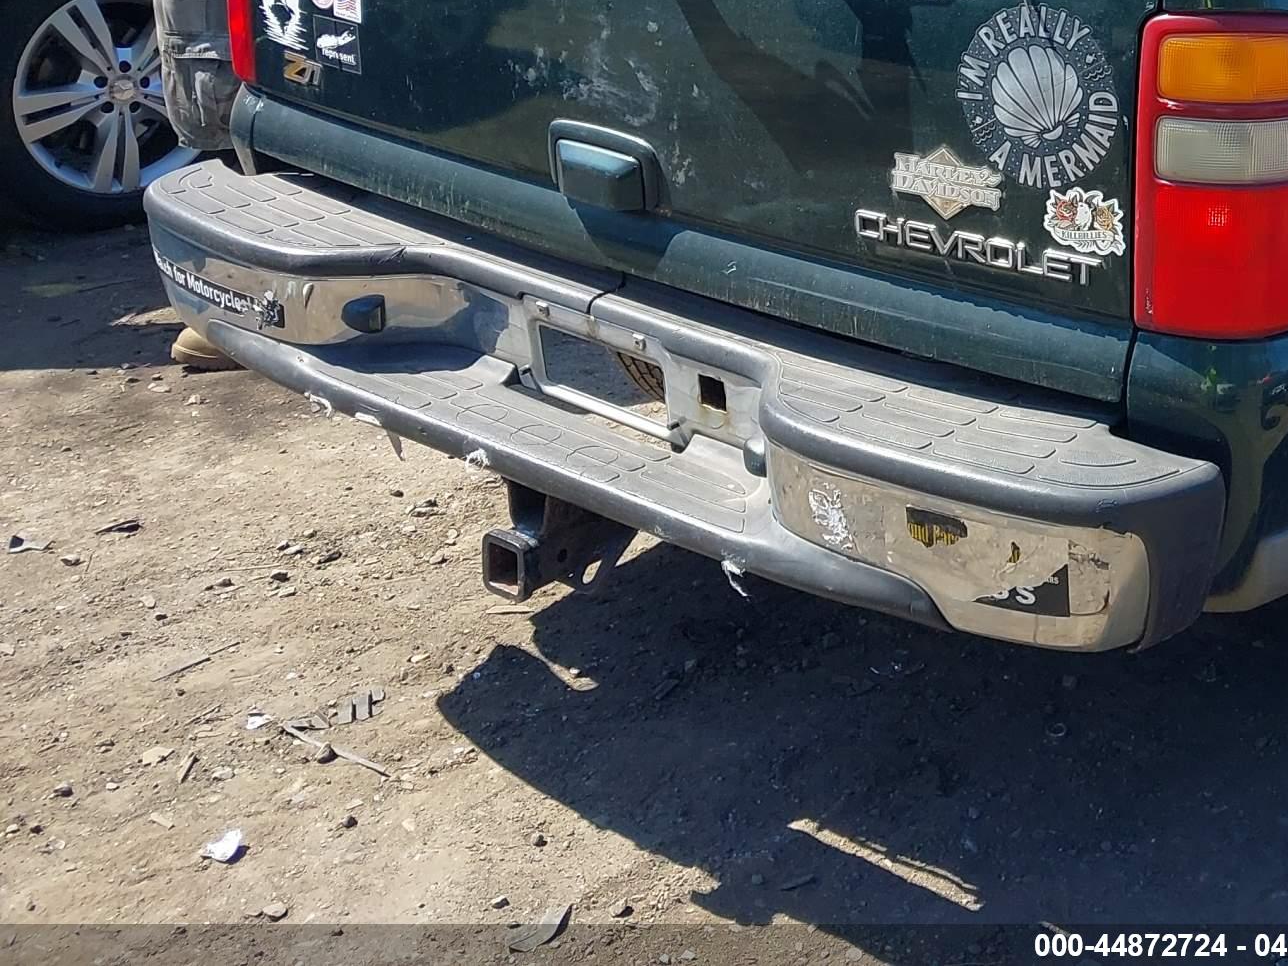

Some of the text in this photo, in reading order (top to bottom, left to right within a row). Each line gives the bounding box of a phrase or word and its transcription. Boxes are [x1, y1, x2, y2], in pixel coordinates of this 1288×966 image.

[957, 3, 1091, 101] I'M REALLY
[989, 91, 1119, 189] A MERMAID
[894, 172, 1000, 210] DAVIDSON
[173, 265, 186, 286] for
[855, 209, 1103, 285] CHEVROLET
